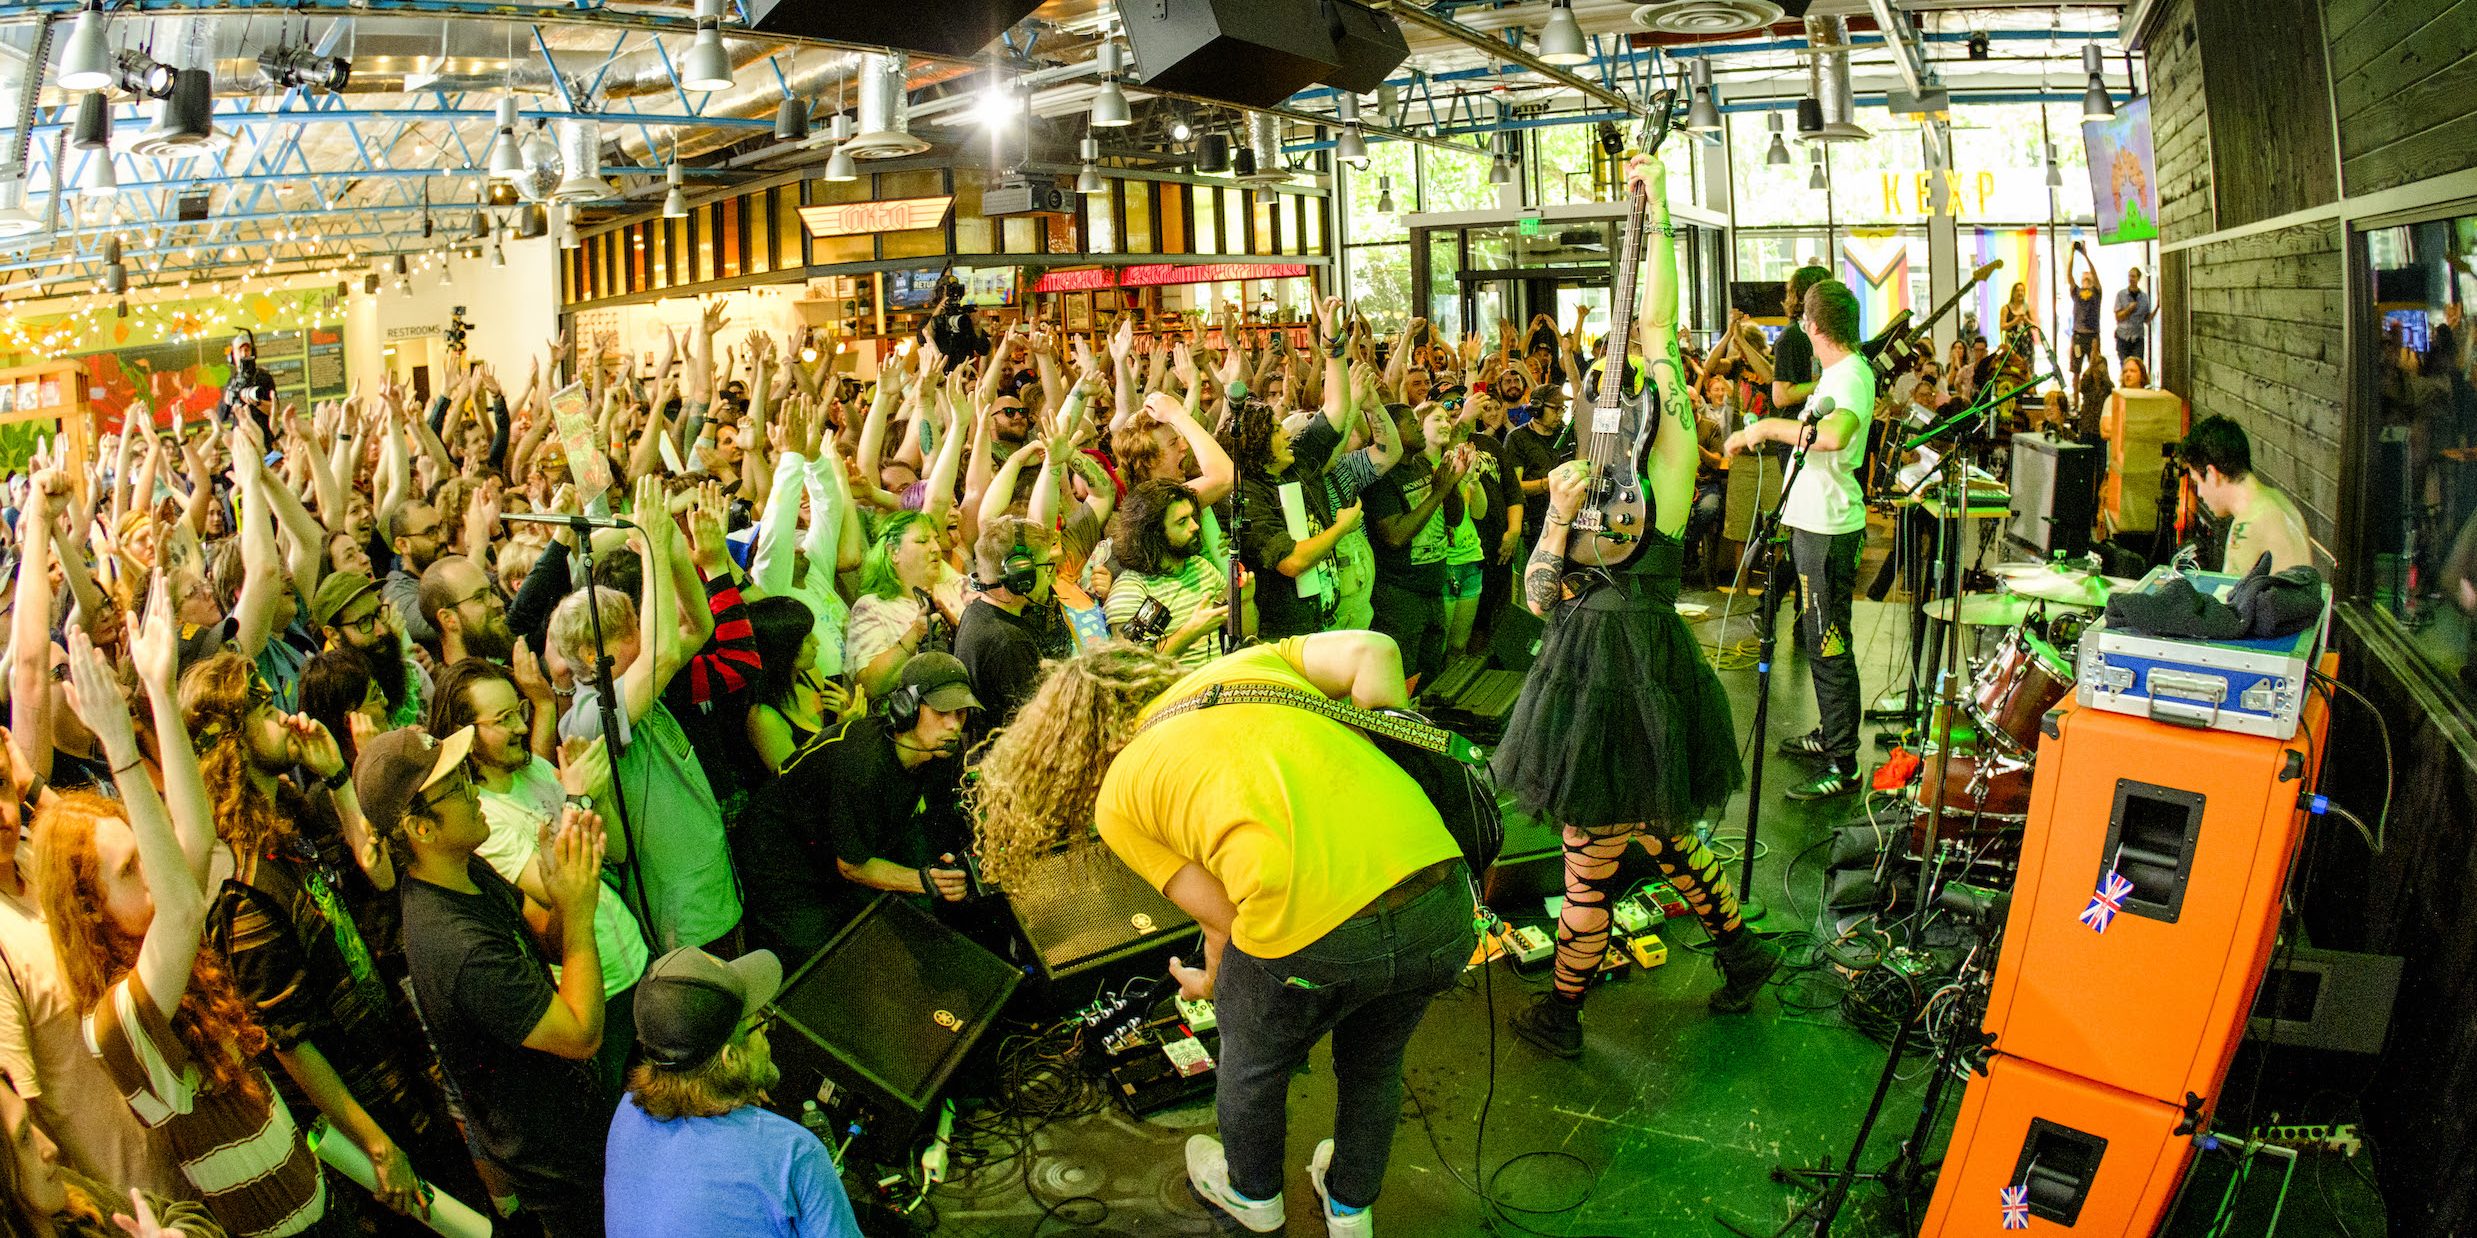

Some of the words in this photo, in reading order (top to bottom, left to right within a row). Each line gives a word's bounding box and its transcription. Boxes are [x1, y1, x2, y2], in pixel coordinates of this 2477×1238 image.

[1881, 169, 1995, 217] KEXP
[913, 280, 937, 290] RETUR
[387, 324, 441, 337] RESTROOMS
[1187, 1004, 1207, 1014] OCD
